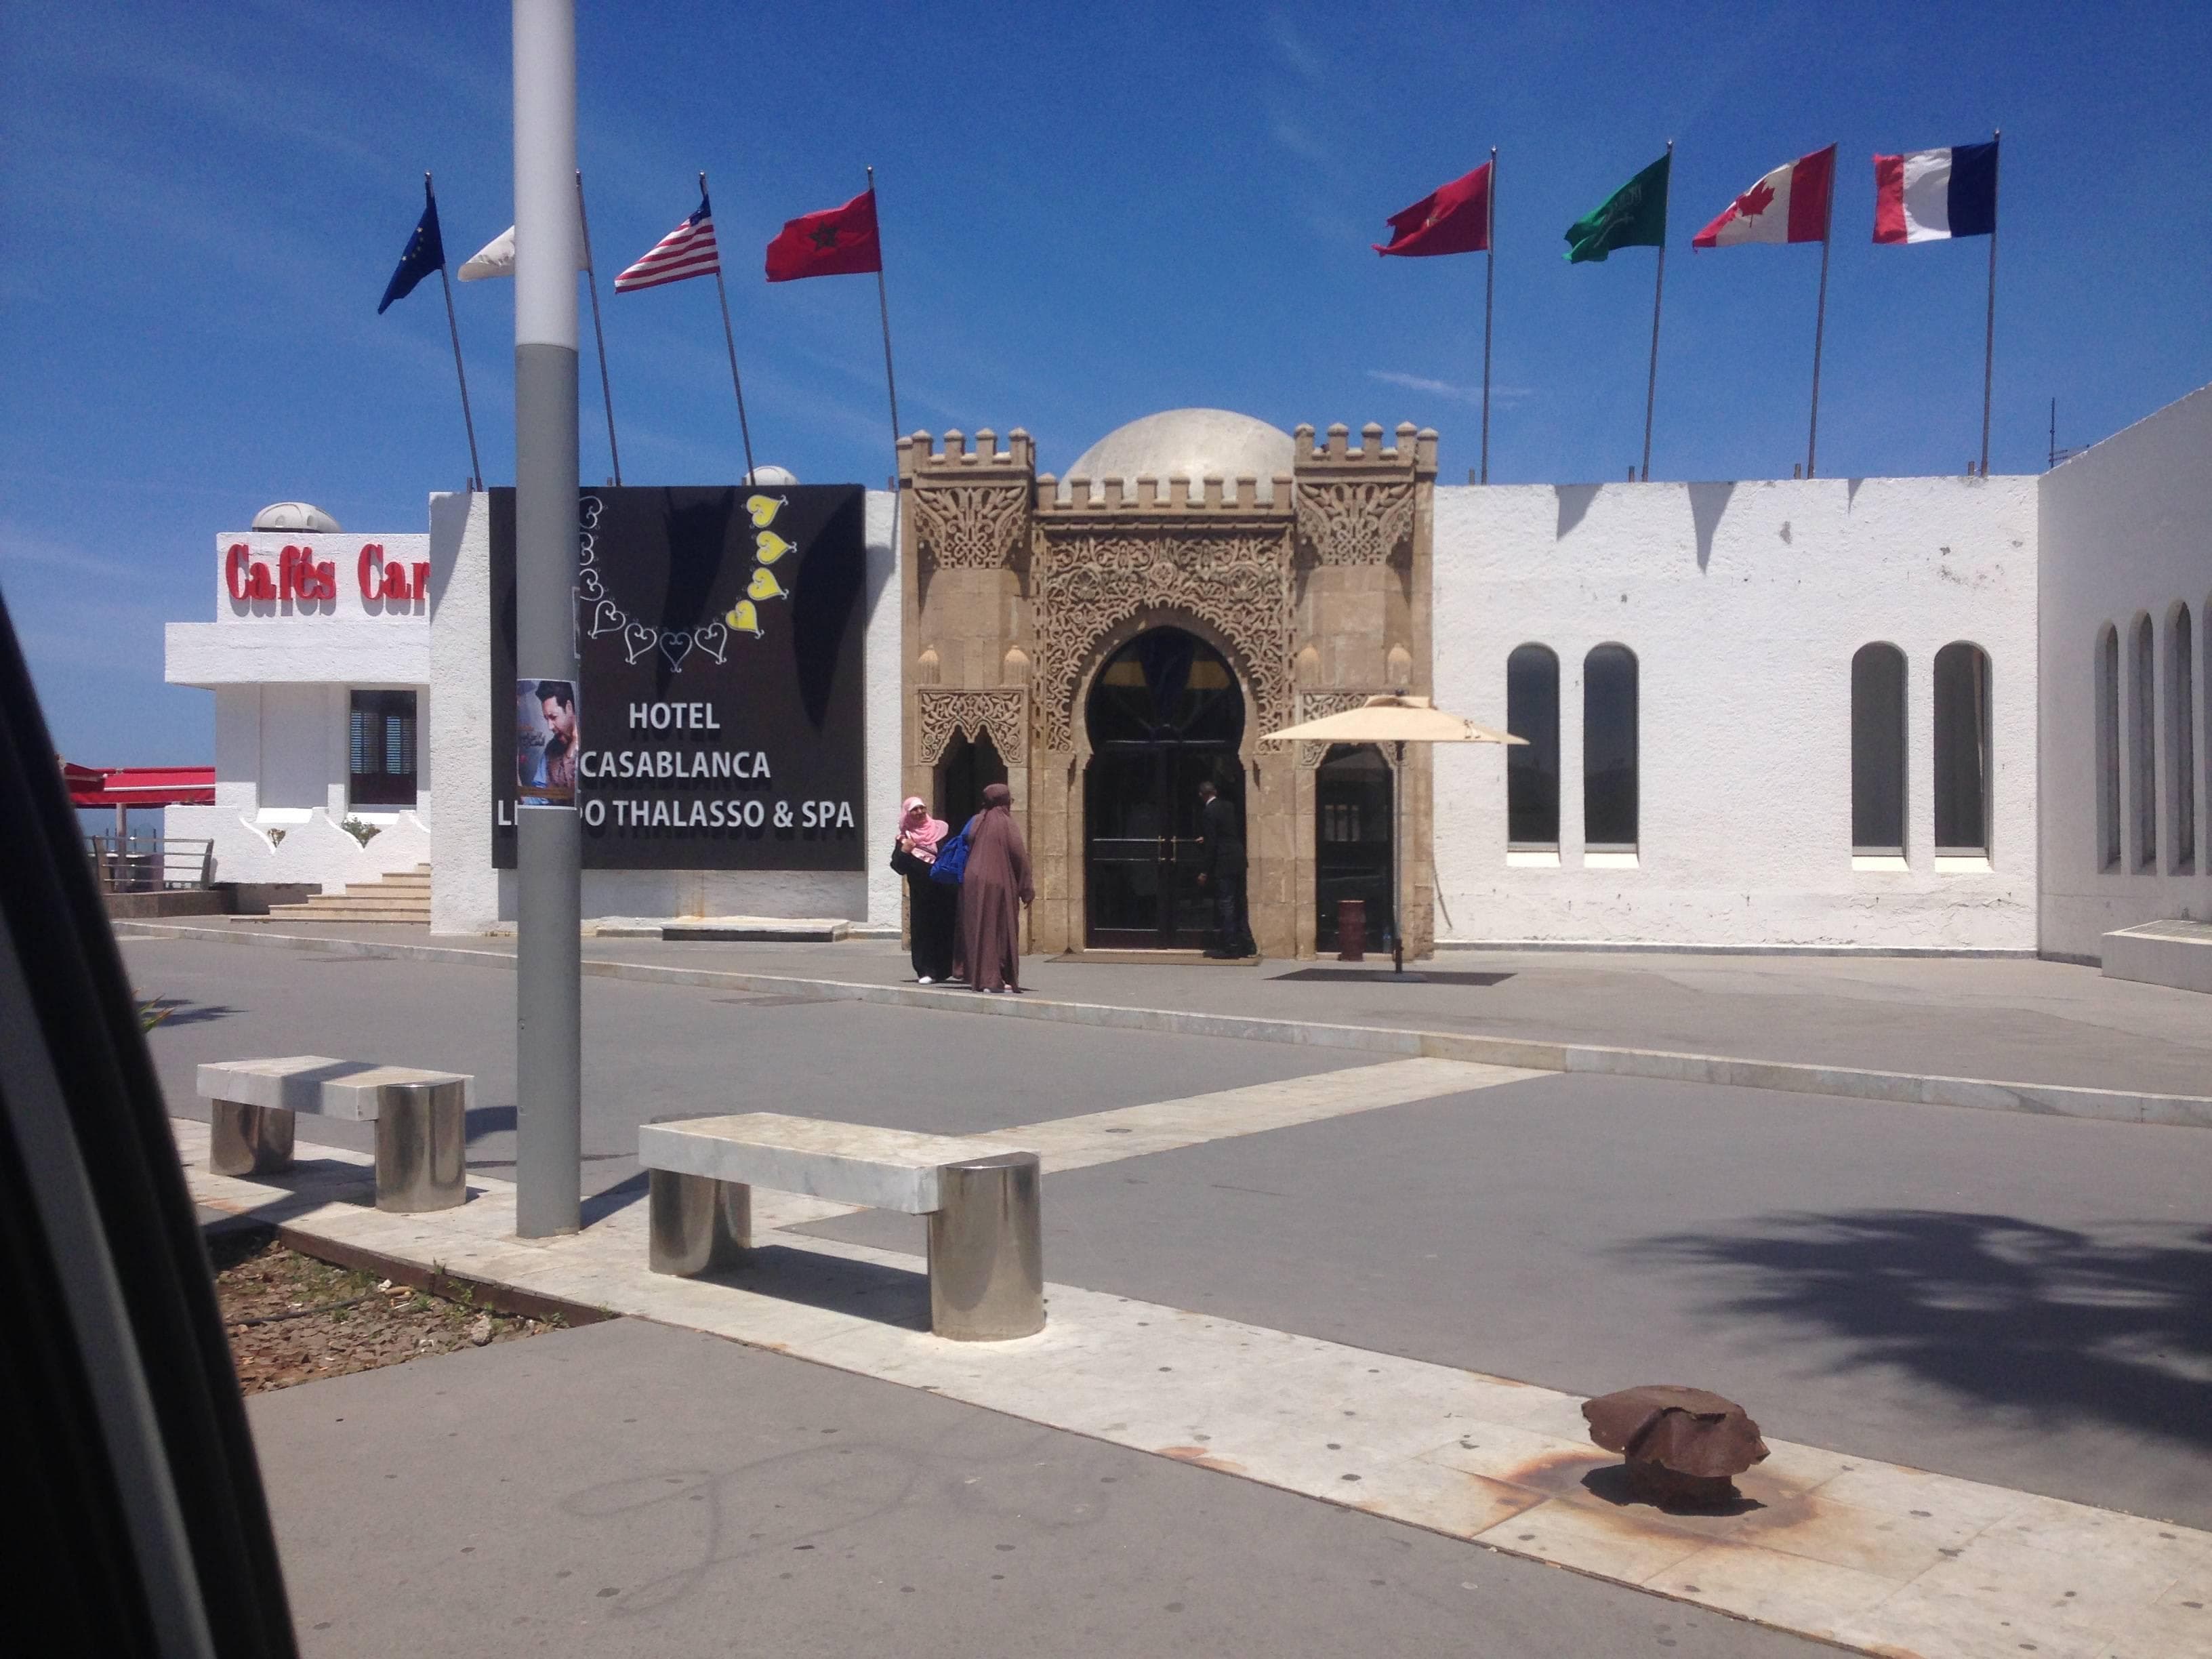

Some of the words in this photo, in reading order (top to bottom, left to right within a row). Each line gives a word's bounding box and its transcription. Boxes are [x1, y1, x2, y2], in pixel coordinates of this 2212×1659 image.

[225, 544, 336, 601] Cafés
[630, 702, 720, 729] HOTEL
[579, 751, 771, 778] CASABLANCA
[612, 800, 764, 827] THALASSO
[773, 800, 794, 828] &
[802, 800, 855, 828] SPA
